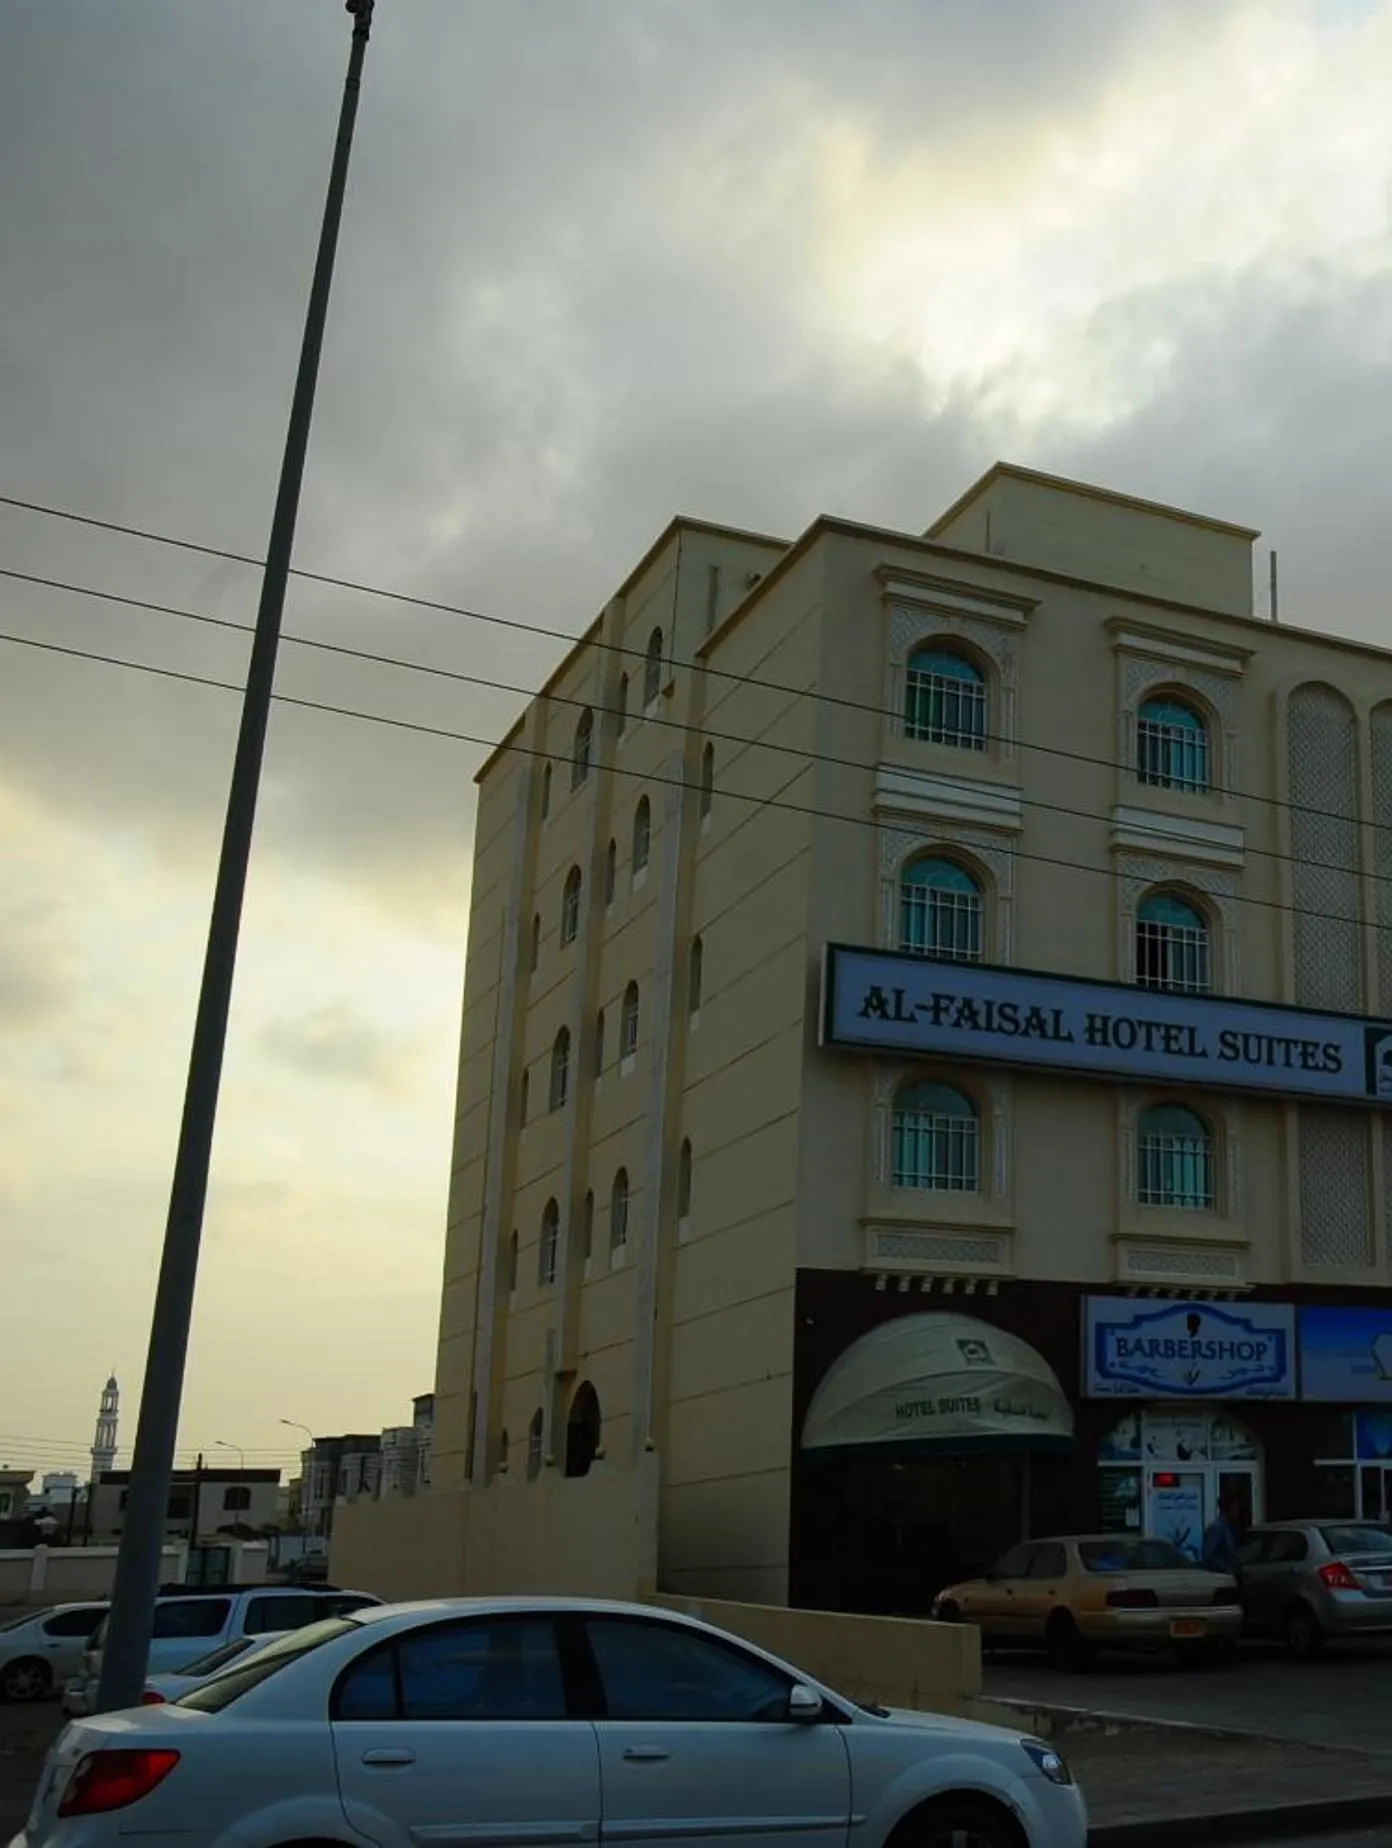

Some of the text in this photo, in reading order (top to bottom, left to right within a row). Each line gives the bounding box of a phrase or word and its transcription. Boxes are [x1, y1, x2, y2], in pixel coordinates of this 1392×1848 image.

[858, 985, 1343, 1074] AL-FAISAL HOTEL SUITES
[1115, 1337, 1268, 1361] BARBERSHOP
[895, 1397, 936, 1420] HOTEL
[938, 1395, 981, 1415] SUITES
